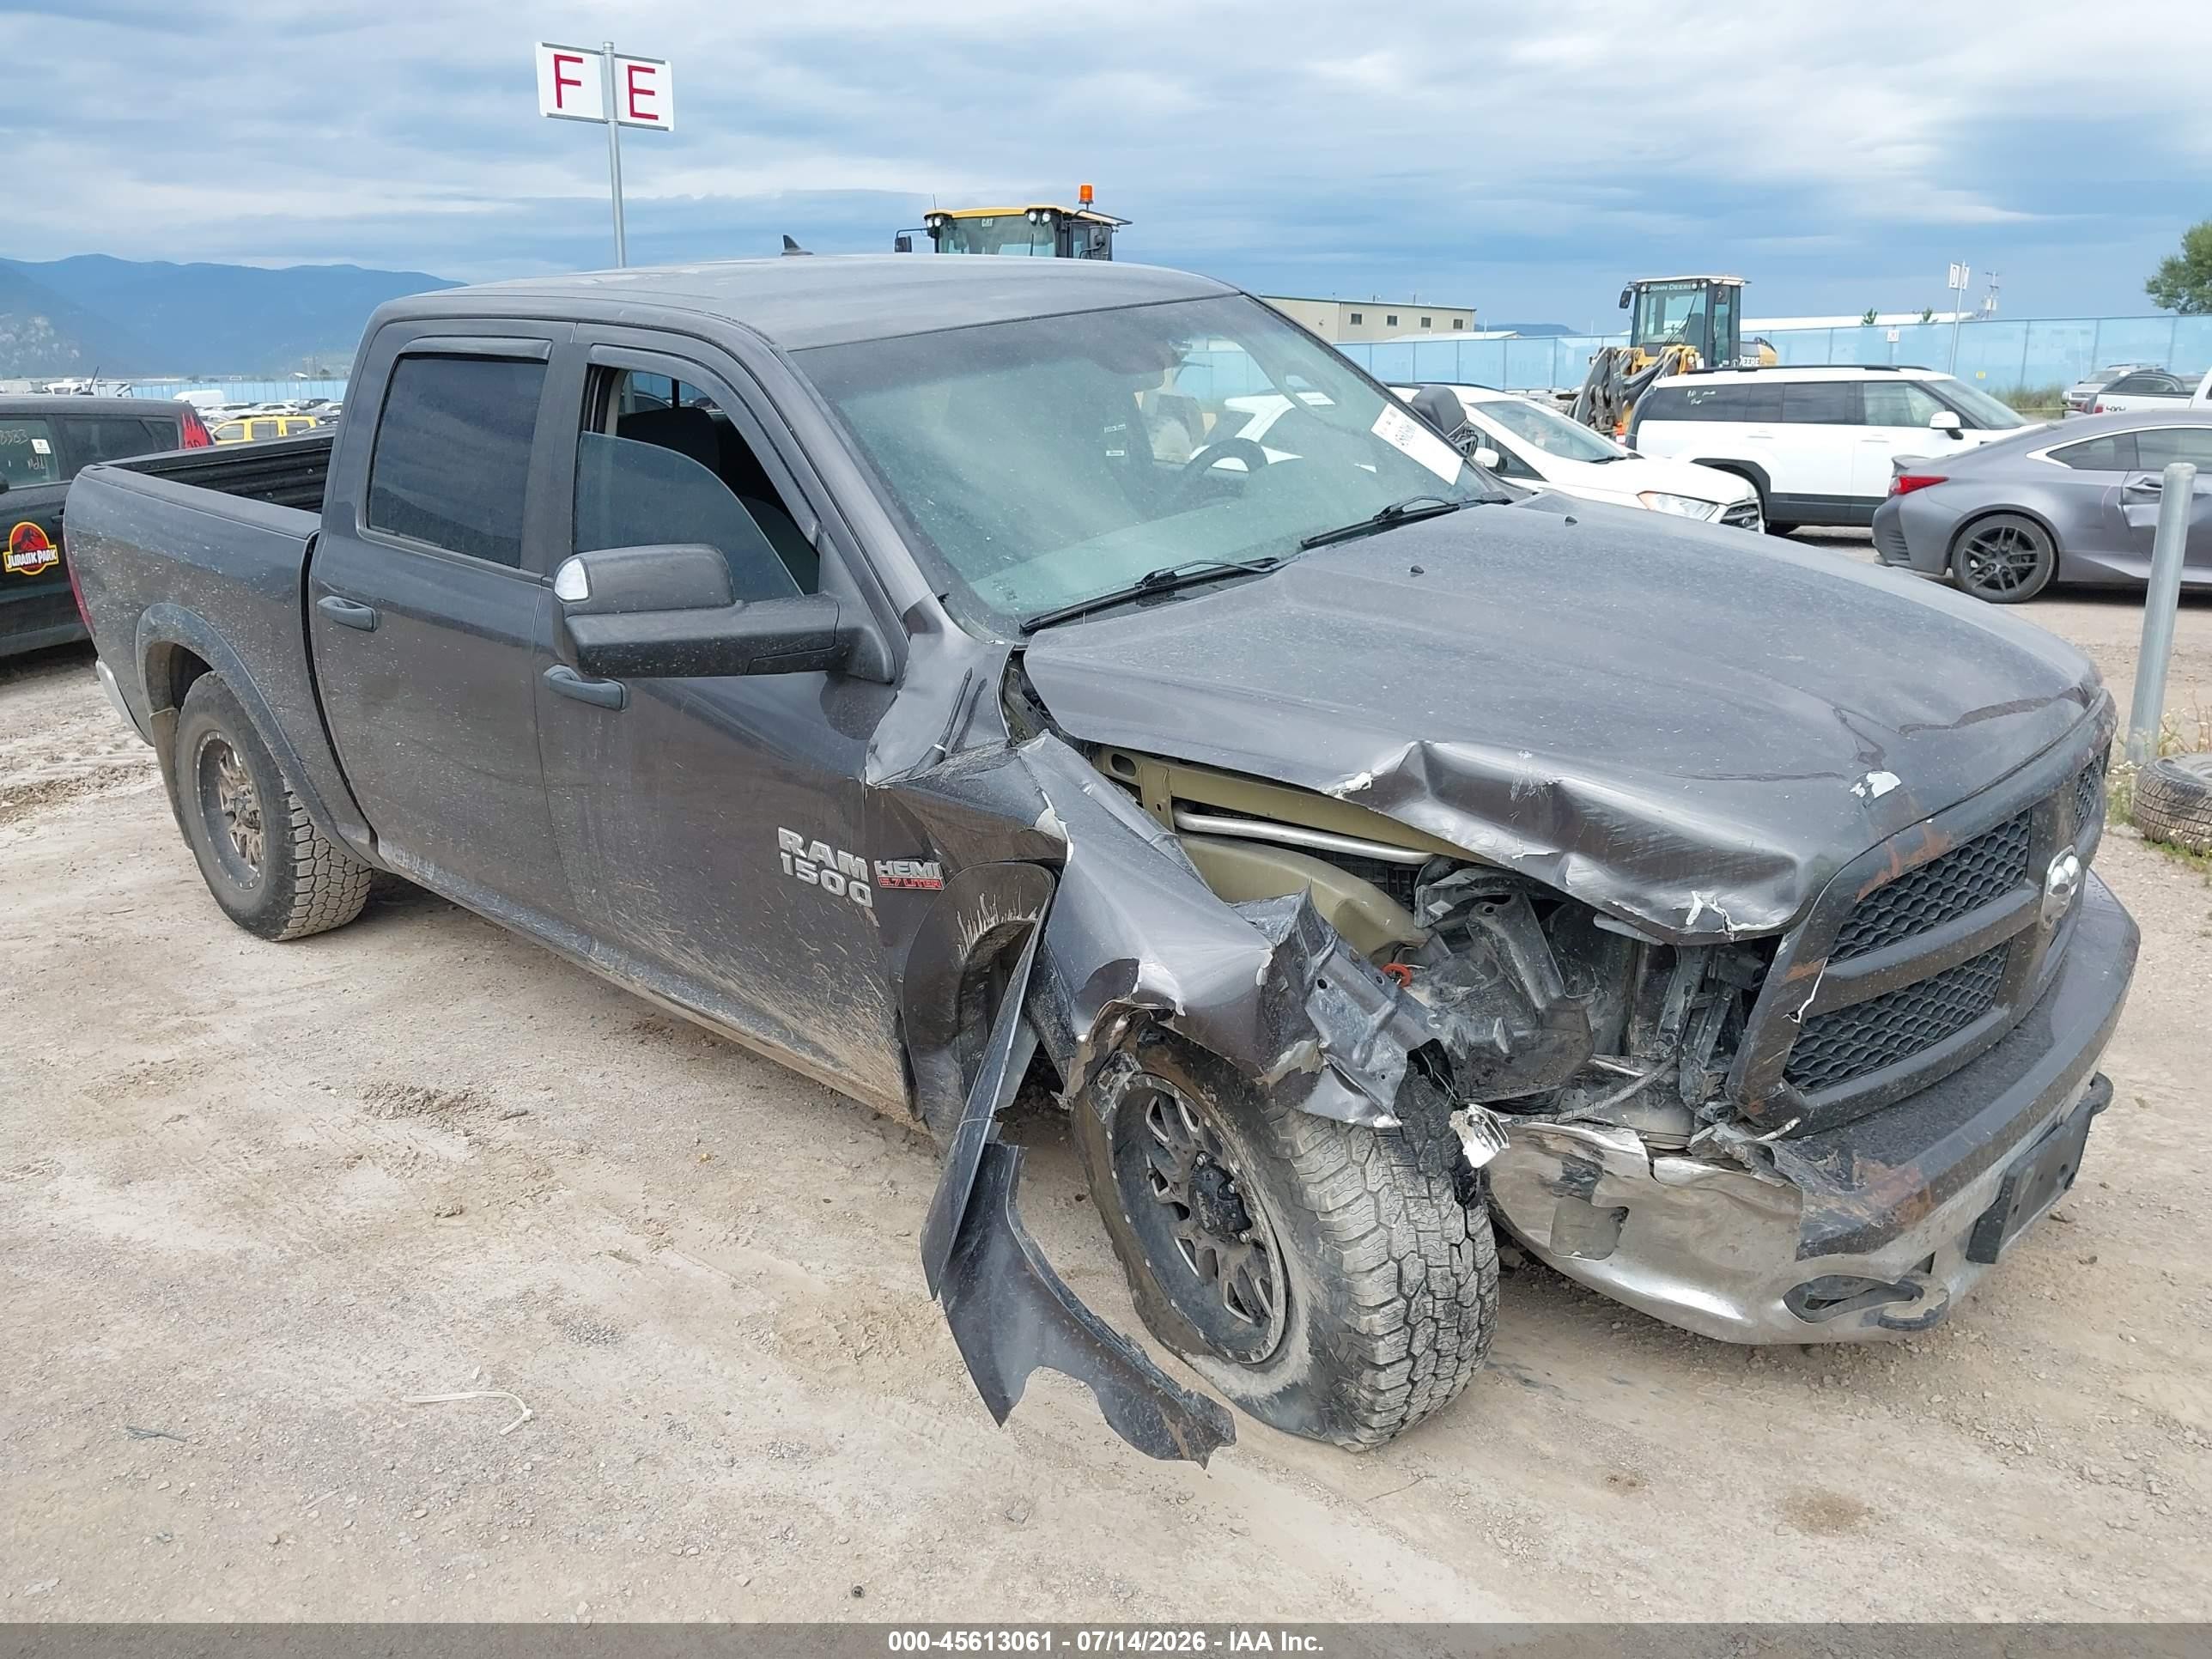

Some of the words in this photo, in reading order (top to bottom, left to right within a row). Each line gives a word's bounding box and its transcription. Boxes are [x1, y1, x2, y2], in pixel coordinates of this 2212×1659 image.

[554, 53, 584, 109] F
[627, 64, 659, 120] E
[36, 549, 57, 564] PARK
[778, 826, 869, 883] RAM
[780, 851, 873, 908] 1500
[874, 860, 942, 878] HEMI
[879, 878, 902, 887] 5.7
[903, 878, 942, 888] LITER
